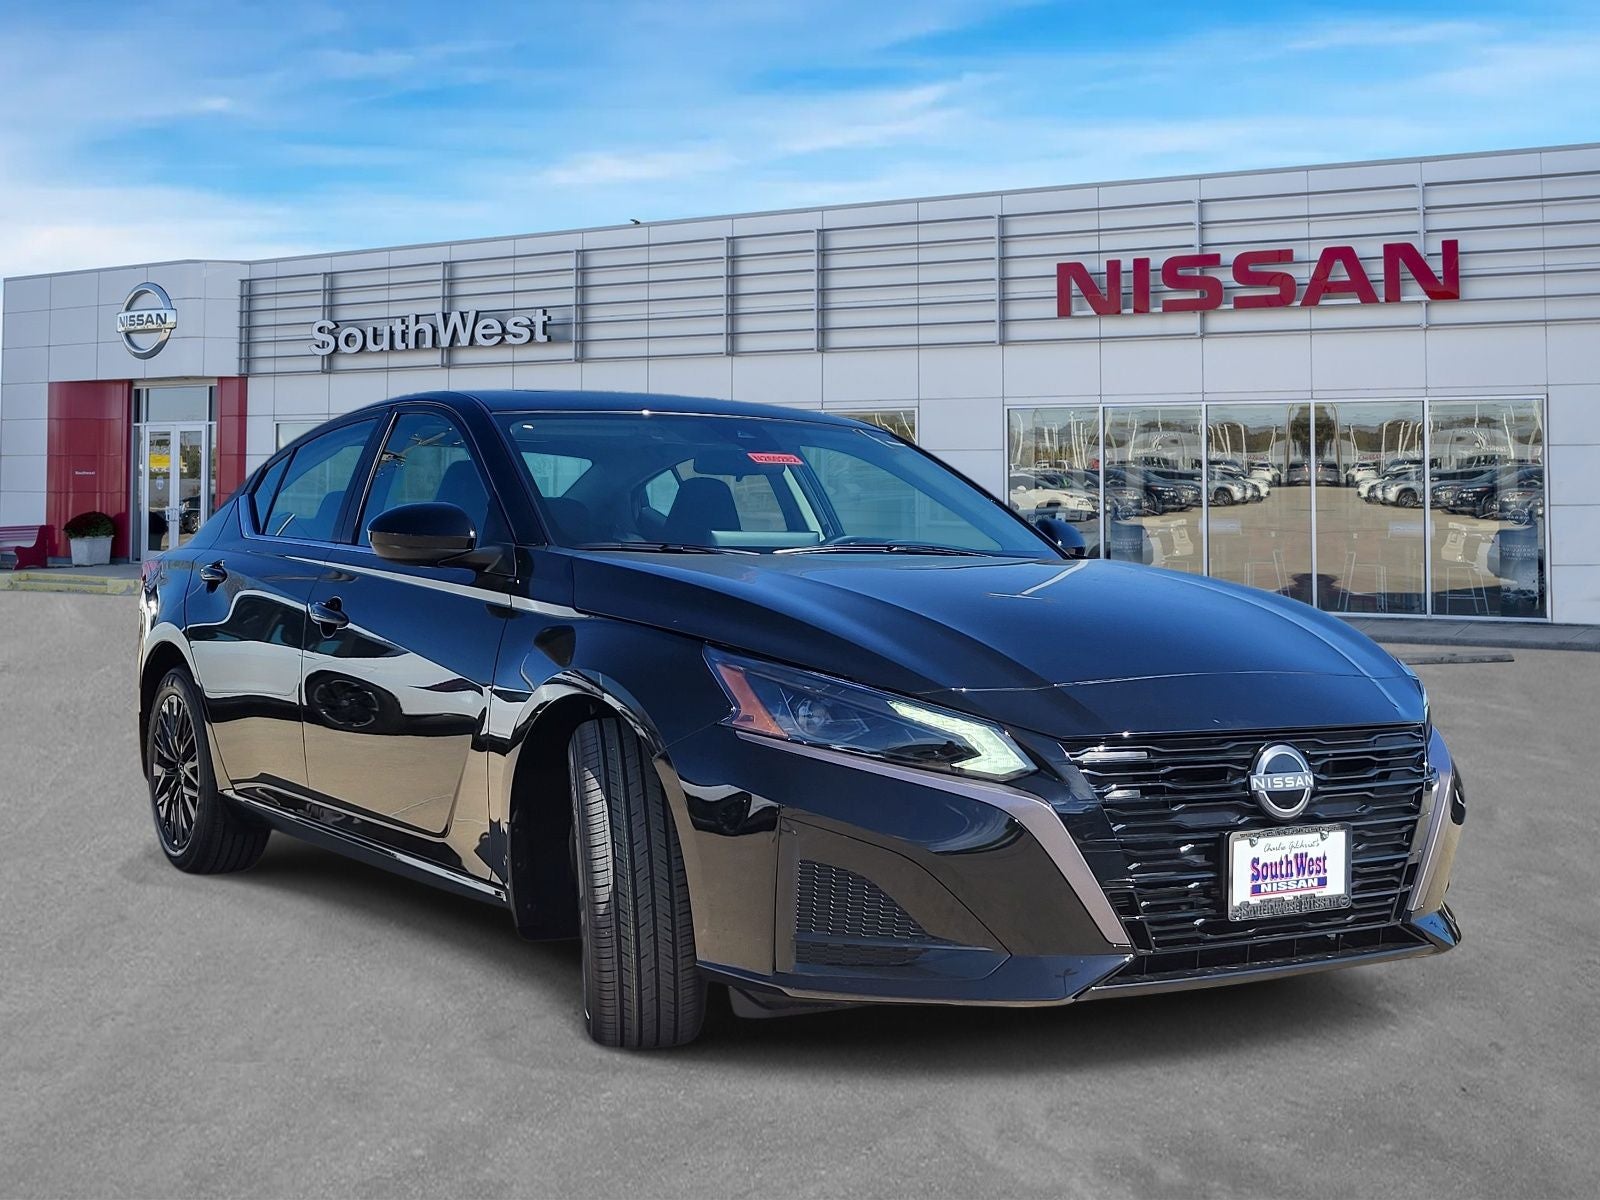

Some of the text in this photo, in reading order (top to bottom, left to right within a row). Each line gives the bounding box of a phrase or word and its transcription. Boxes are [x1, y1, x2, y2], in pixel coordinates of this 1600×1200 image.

[1056, 239, 1460, 318] NISSAN
[119, 312, 168, 328] NISSAN
[308, 308, 552, 356] SouthWest
[1252, 774, 1314, 789] NISSAN
[1260, 877, 1319, 893] NISSAN
